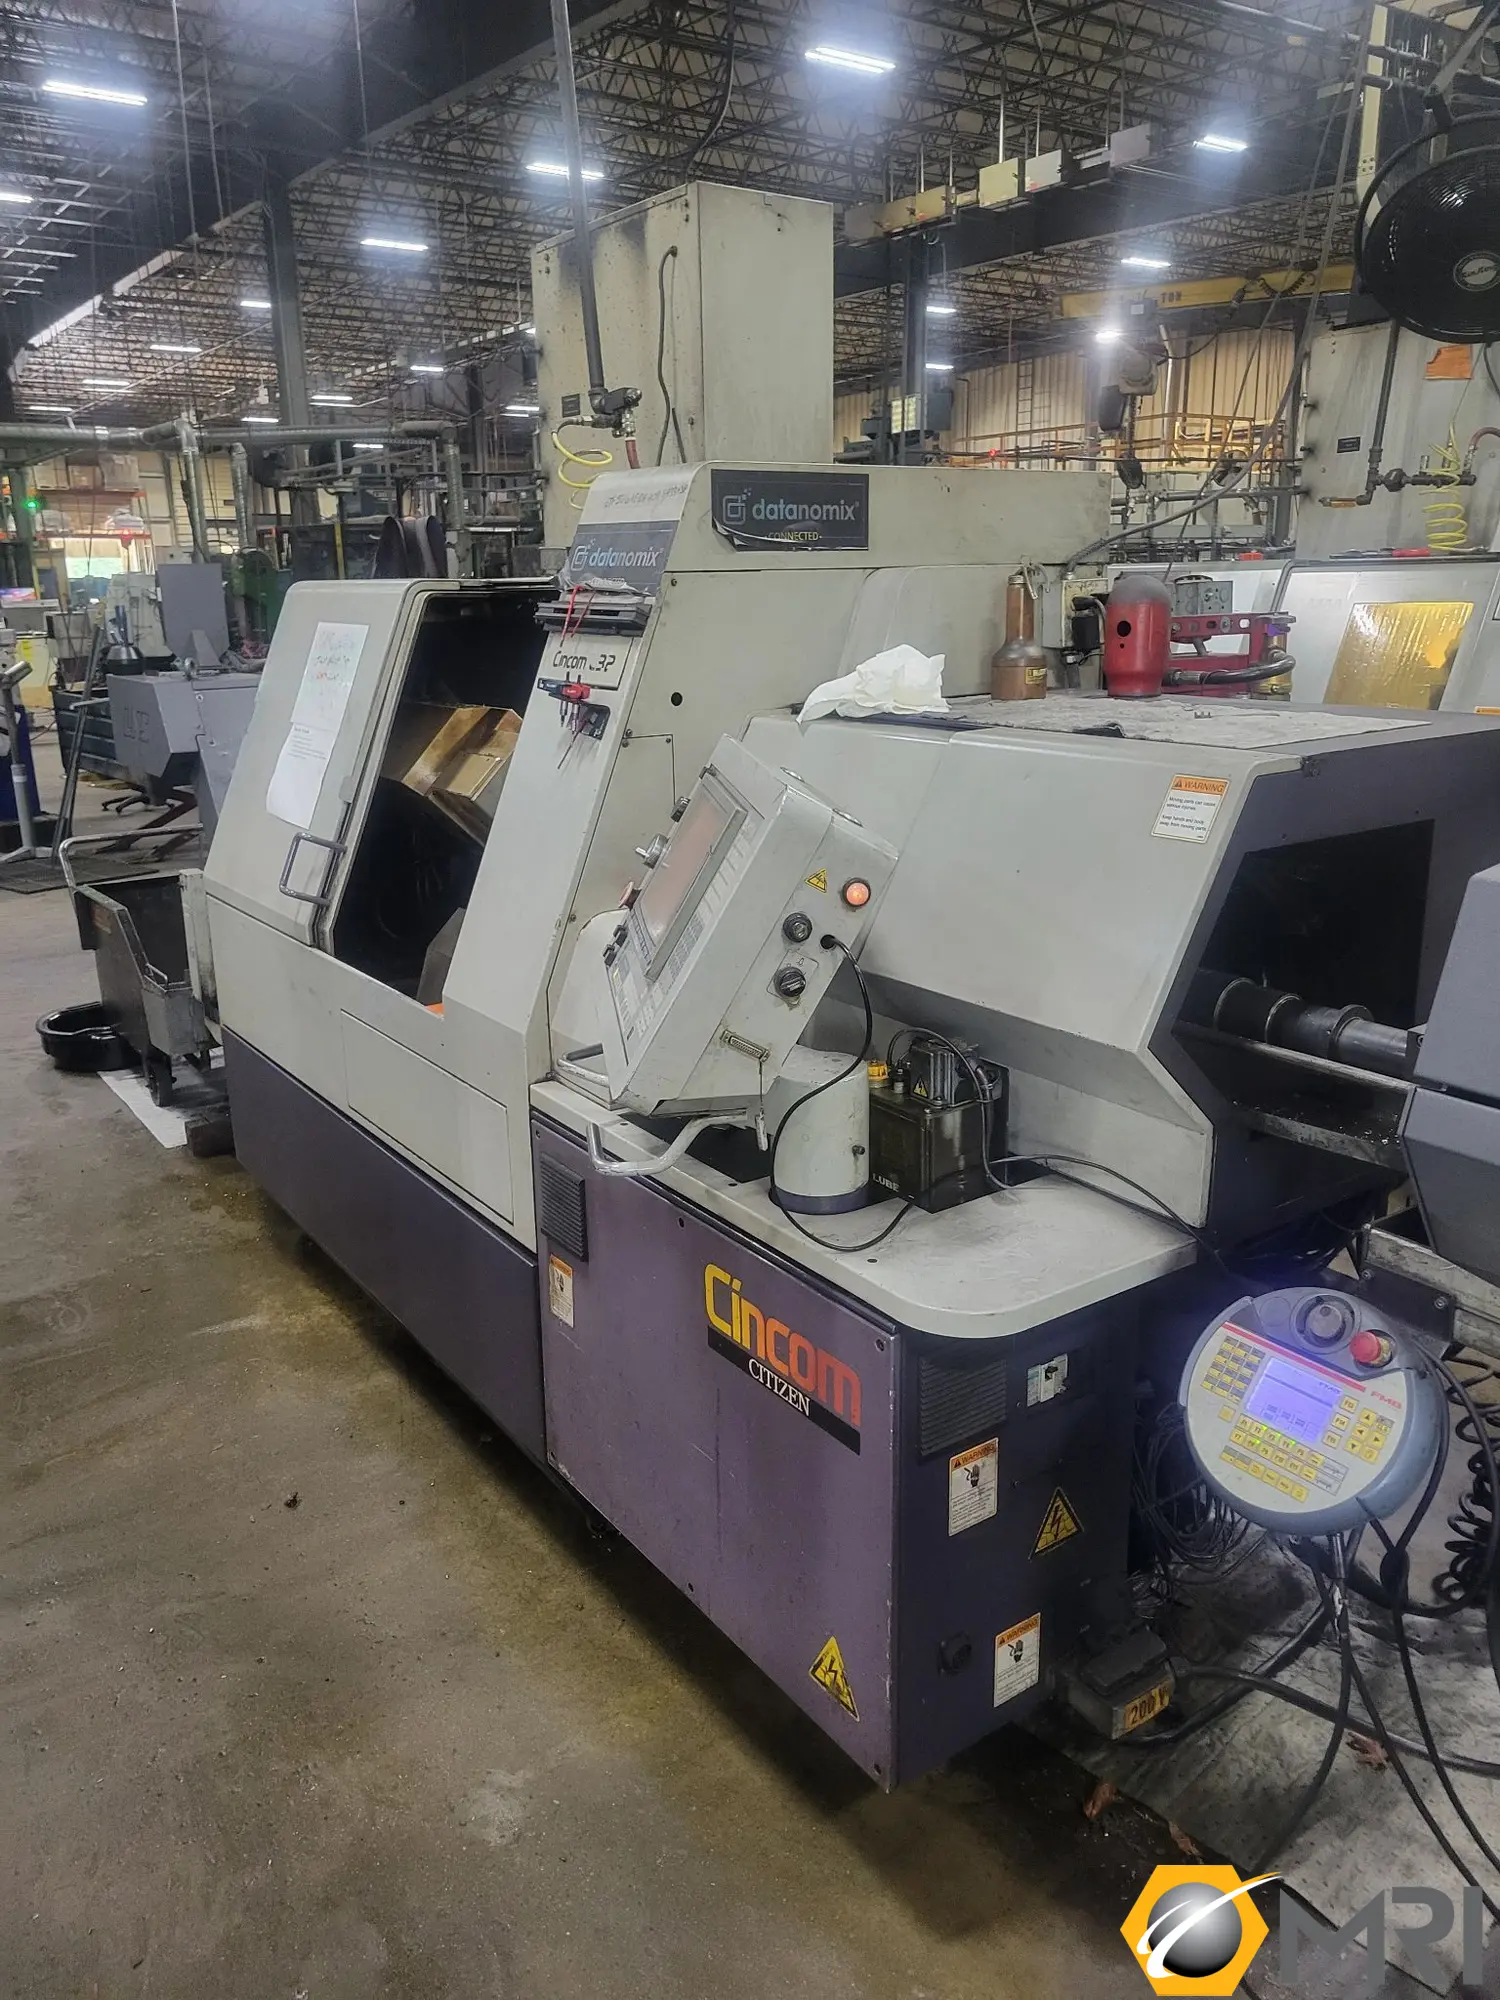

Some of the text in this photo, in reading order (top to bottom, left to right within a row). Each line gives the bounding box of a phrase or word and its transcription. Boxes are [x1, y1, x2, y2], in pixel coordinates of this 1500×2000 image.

[752, 498, 856, 521] datanomix
[768, 531, 819, 541] CONNECTED
[588, 547, 659, 567] datanomix
[553, 650, 587, 670] Cincom
[1184, 782, 1224, 793] WARNING
[872, 1172, 900, 1193] LUBE
[704, 1263, 862, 1428] Cincom
[748, 1358, 811, 1417] CITIZEN
[961, 1443, 995, 1464] WARNING
